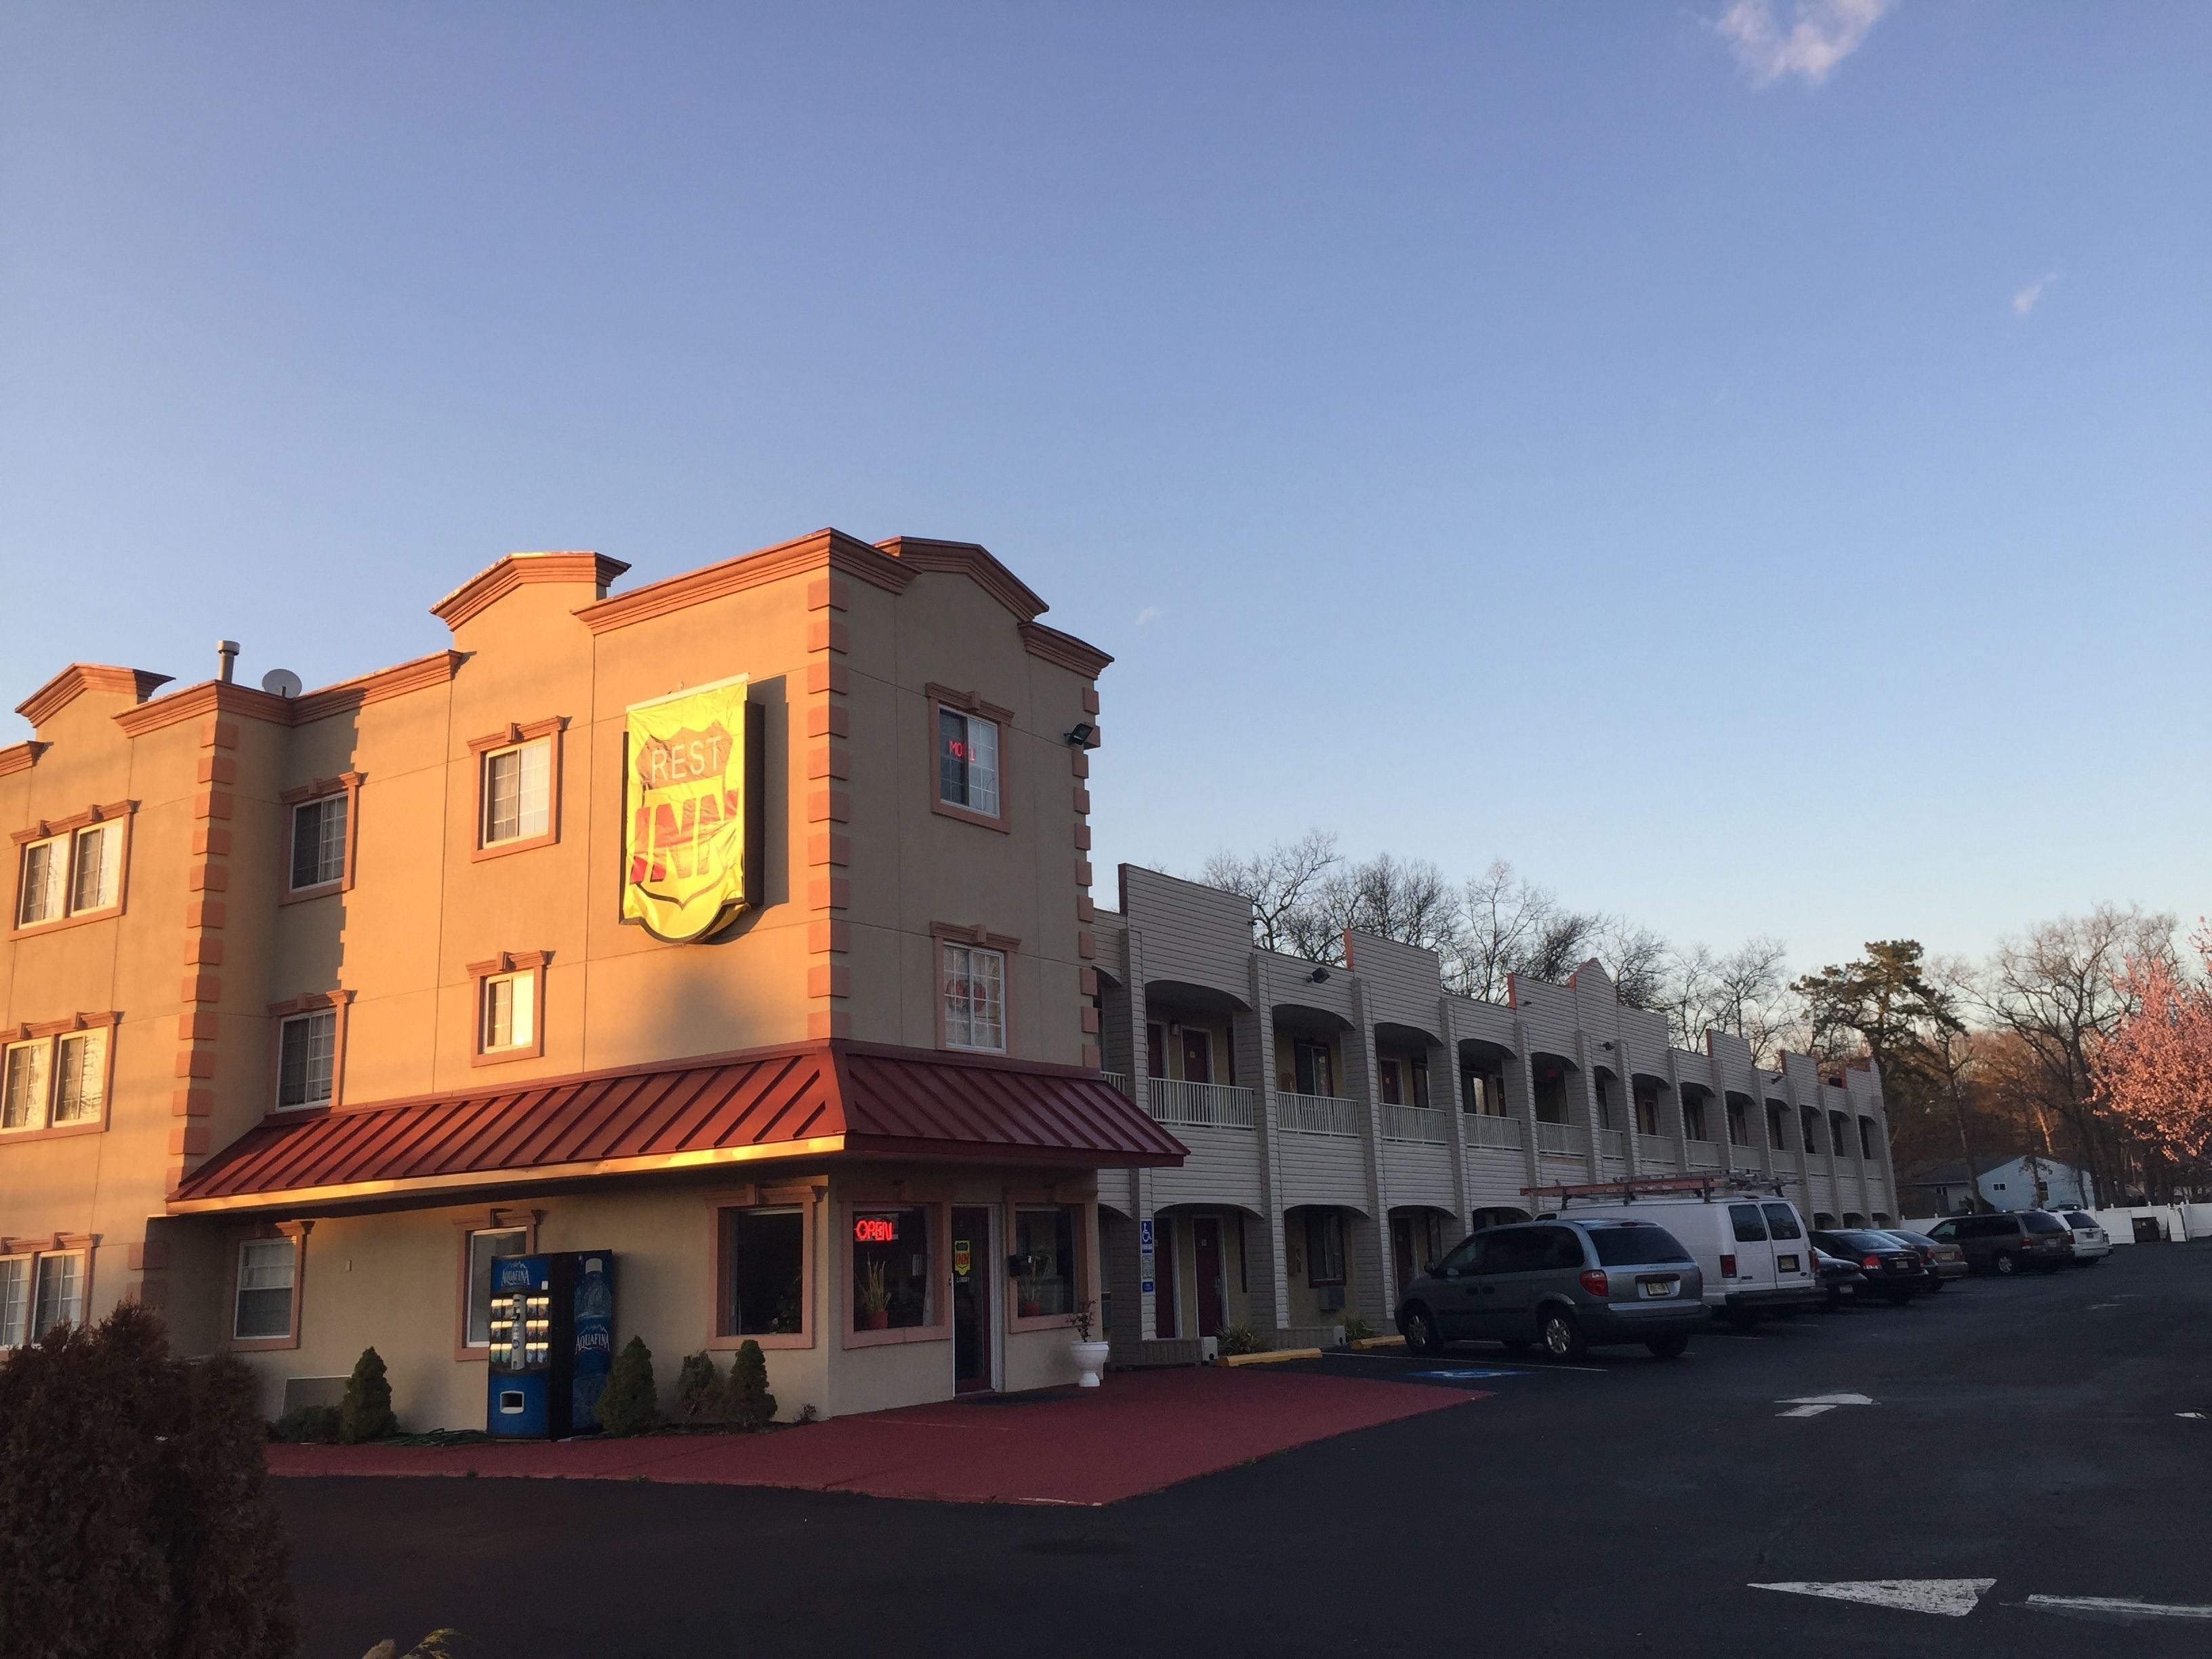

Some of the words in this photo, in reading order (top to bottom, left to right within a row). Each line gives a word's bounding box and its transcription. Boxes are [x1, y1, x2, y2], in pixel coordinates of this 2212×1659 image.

[651, 735, 722, 784] REST
[629, 787, 739, 885] INN
[856, 1220, 893, 1241] OPEN
[501, 1269, 530, 1286] AQUAFINA
[575, 1333, 610, 1355] AQUAFINA
